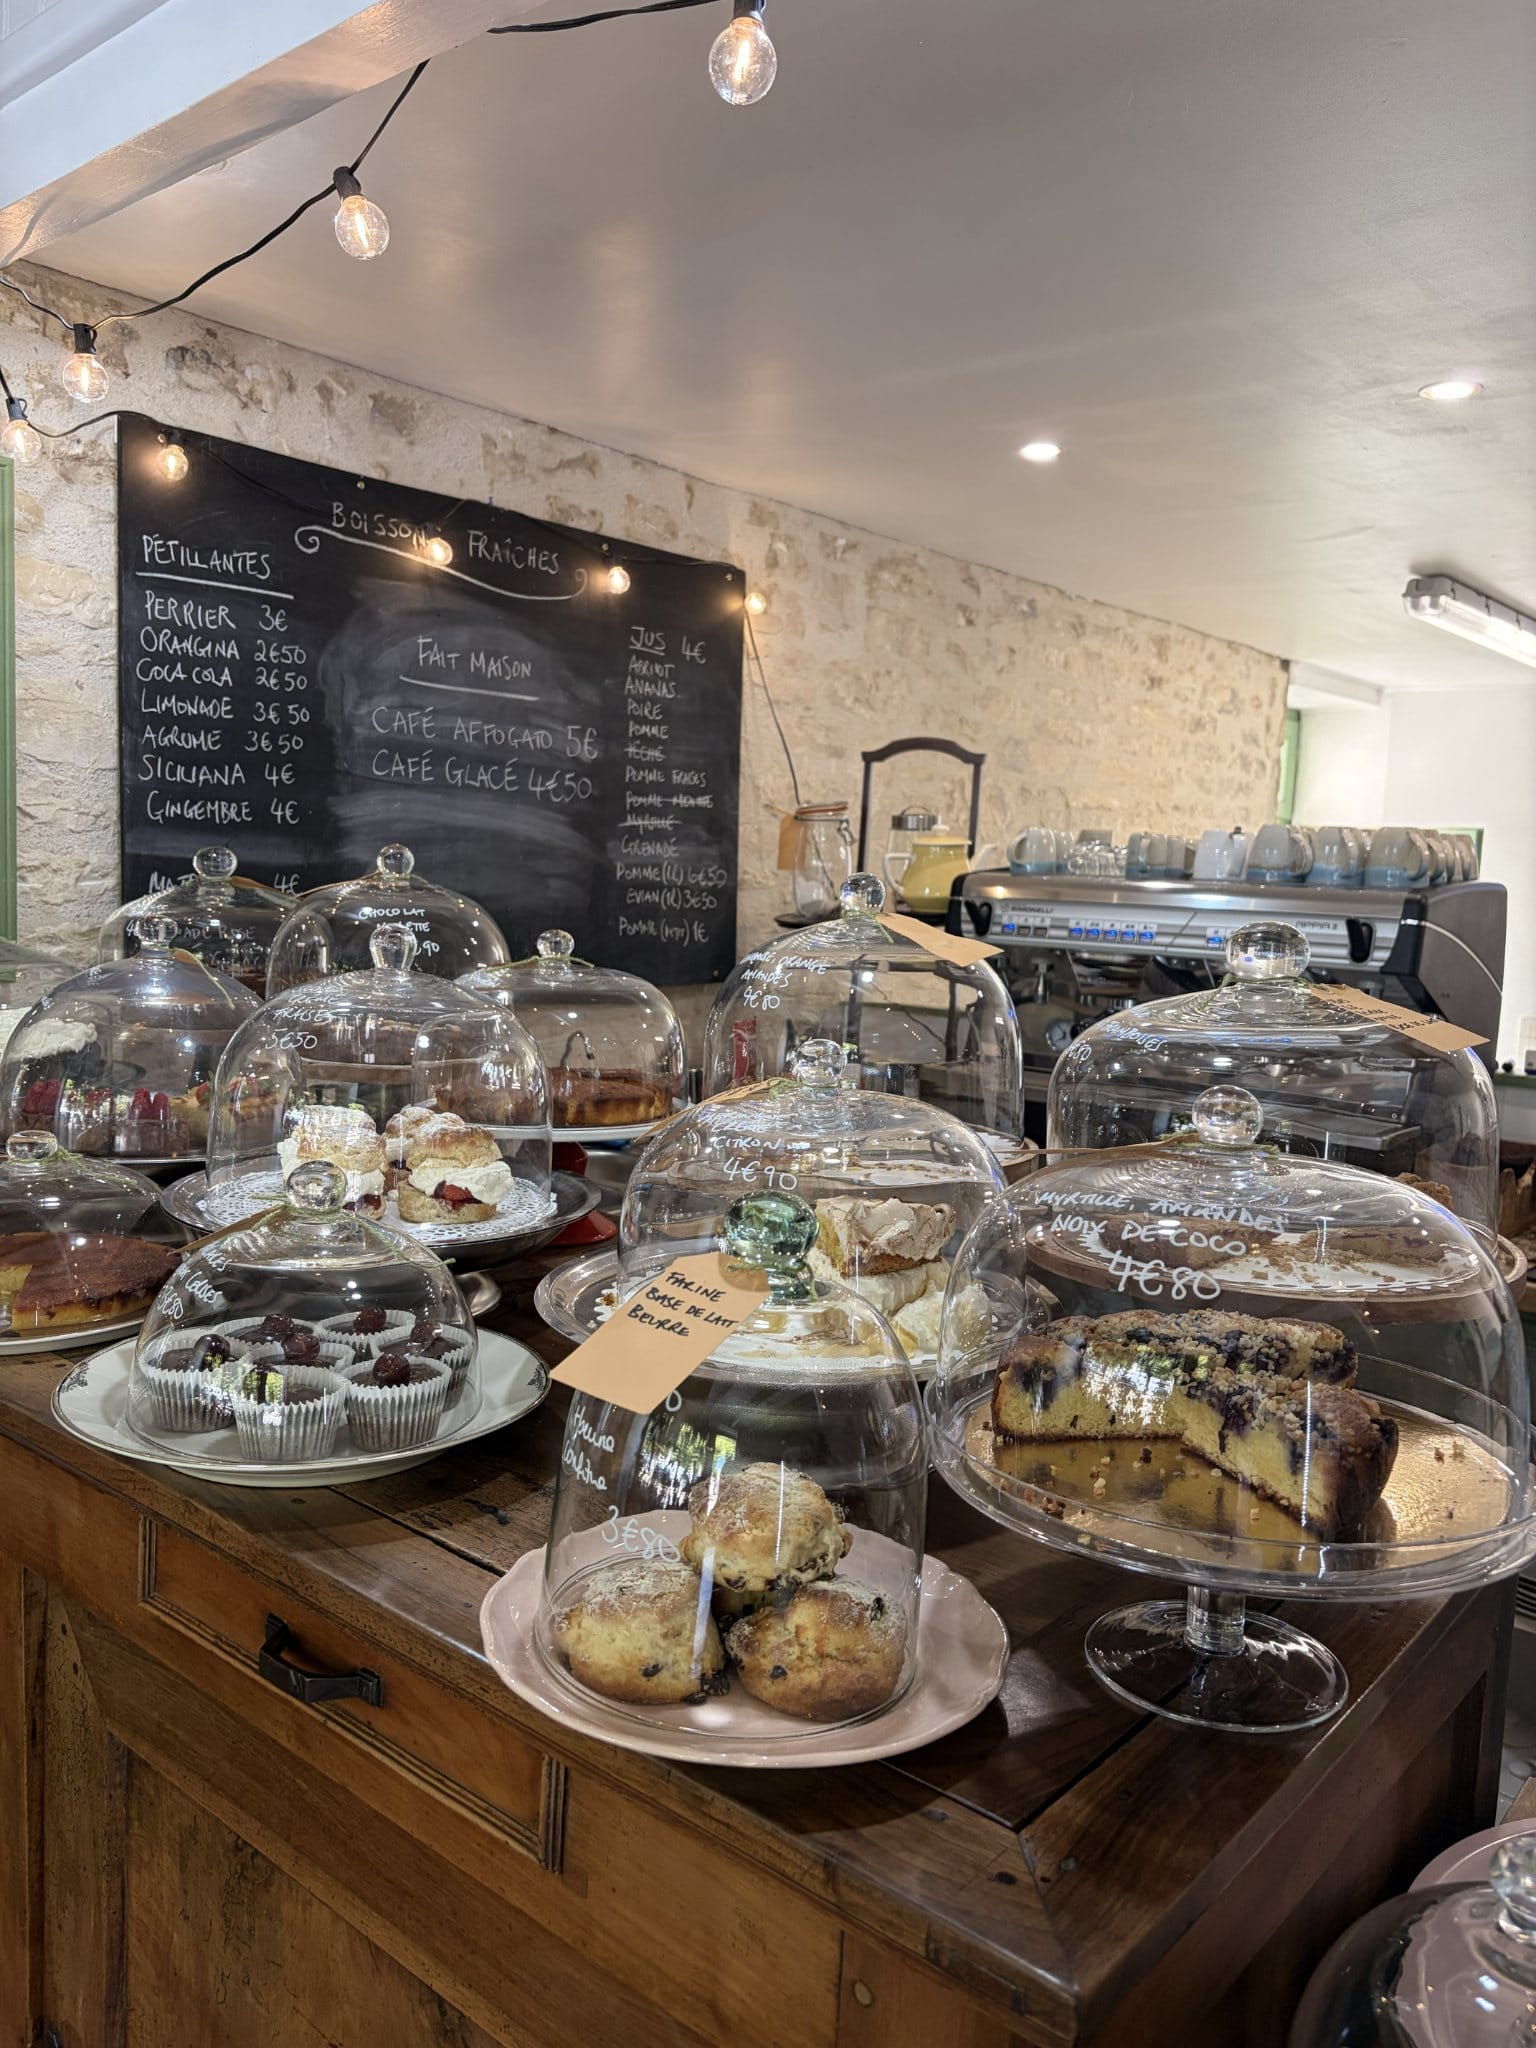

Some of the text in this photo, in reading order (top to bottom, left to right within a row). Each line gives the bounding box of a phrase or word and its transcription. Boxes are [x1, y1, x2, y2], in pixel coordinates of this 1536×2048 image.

[142, 533, 271, 580] PÉTILLANTES
[145, 591, 288, 632] PERRIER 3€
[140, 627, 240, 661] ORANGINA
[417, 635, 532, 681] FAIT MAISON
[630, 626, 706, 665] JUS 4€
[192, 667, 233, 688] COLA
[624, 675, 677, 698] ANANAS
[141, 688, 234, 719] LIMONADE
[627, 698, 663, 720] POIRE
[141, 728, 222, 751] AGRUME
[372, 705, 599, 760] CAFÉ AFFOGATO 5€
[628, 721, 670, 739] POMME
[138, 754, 296, 787] SICILIANA 4€
[372, 749, 592, 802] CAFÉ GLACÉ 4€50
[625, 765, 665, 784] POMME
[146, 790, 300, 825] GINGEMBRE 4€
[616, 862, 661, 881] POMME
[619, 916, 659, 937] POMME
[777, 955, 832, 975] ORANGE
[743, 985, 780, 1011] 4€80
[265, 1028, 318, 1050] 5€50
[723, 1156, 798, 1190] 4€90
[1150, 1199, 1289, 1234] AMANDES
[1050, 1214, 1247, 1256] NOIX DE COCO
[666, 1271, 726, 1303] FARINE
[1108, 1250, 1222, 1300] 4€80
[645, 1287, 685, 1312] BASE
[686, 1305, 705, 1318] DE
[627, 1304, 690, 1338] BEURRE
[602, 1505, 682, 1563] 3€80
